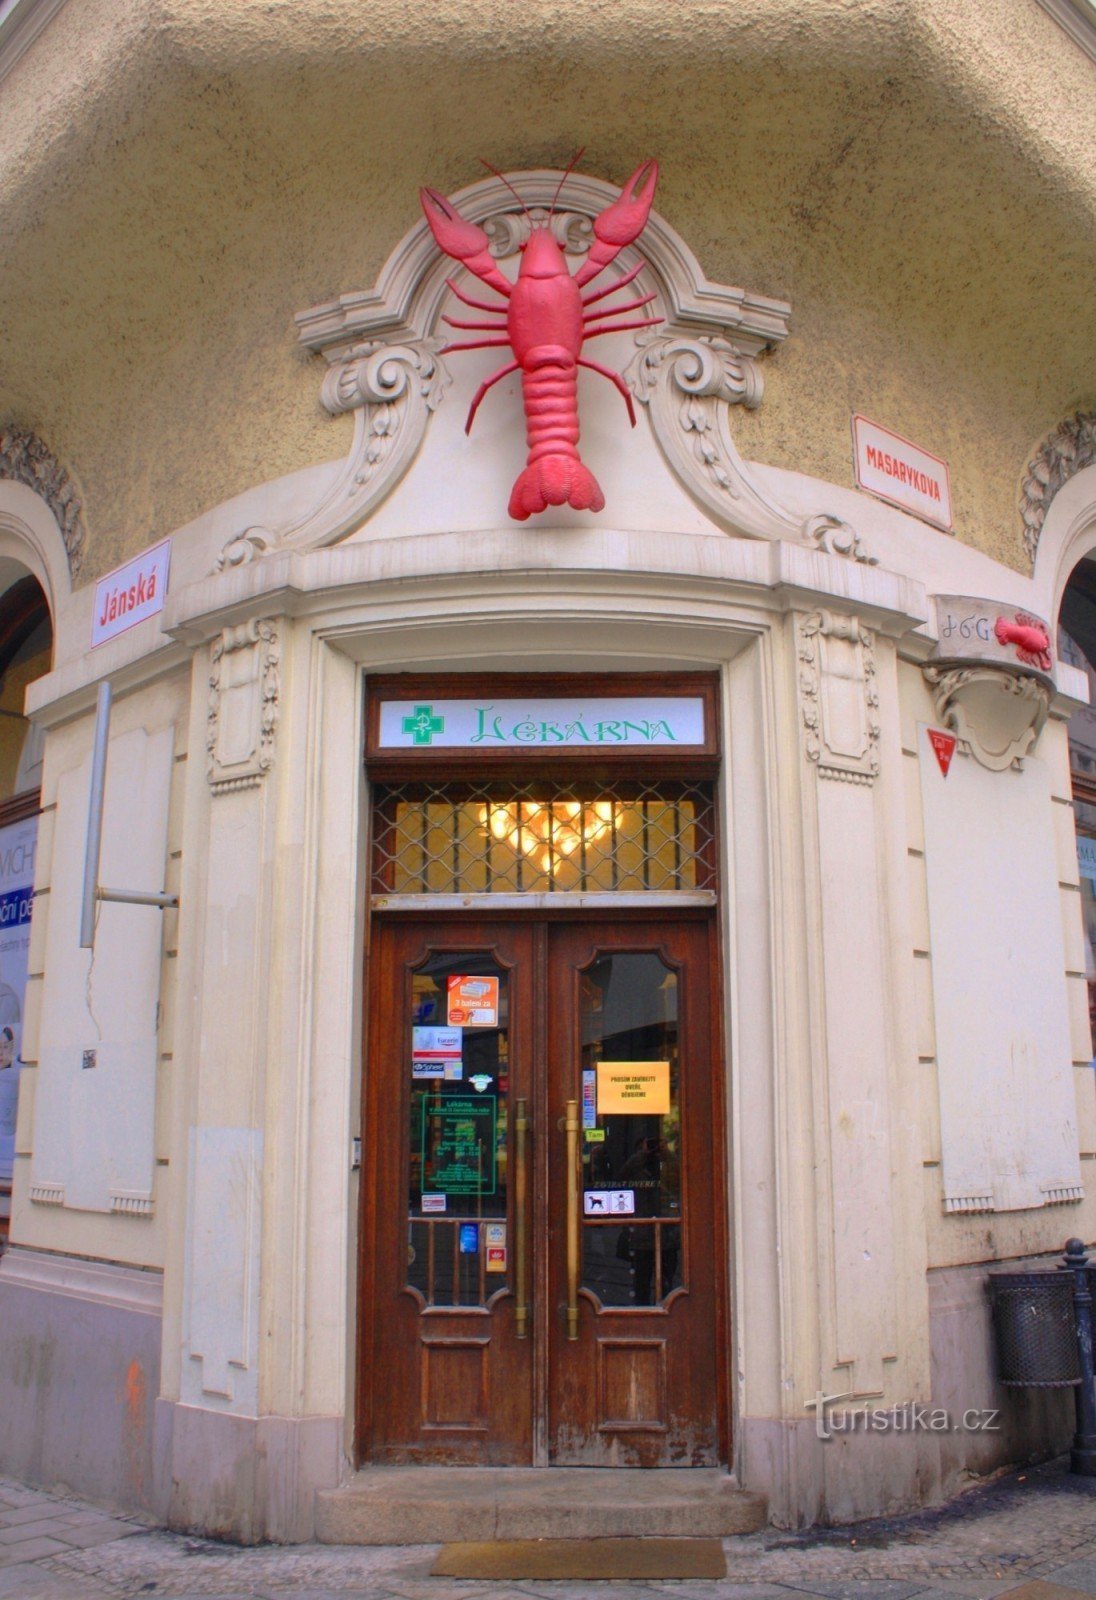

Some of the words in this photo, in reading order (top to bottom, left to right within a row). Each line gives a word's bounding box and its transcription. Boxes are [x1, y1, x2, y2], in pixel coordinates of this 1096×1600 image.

[865, 444, 941, 502] MASARYKOVA
[100, 565, 157, 626] Jánská
[0, 896, 18, 924] ční
